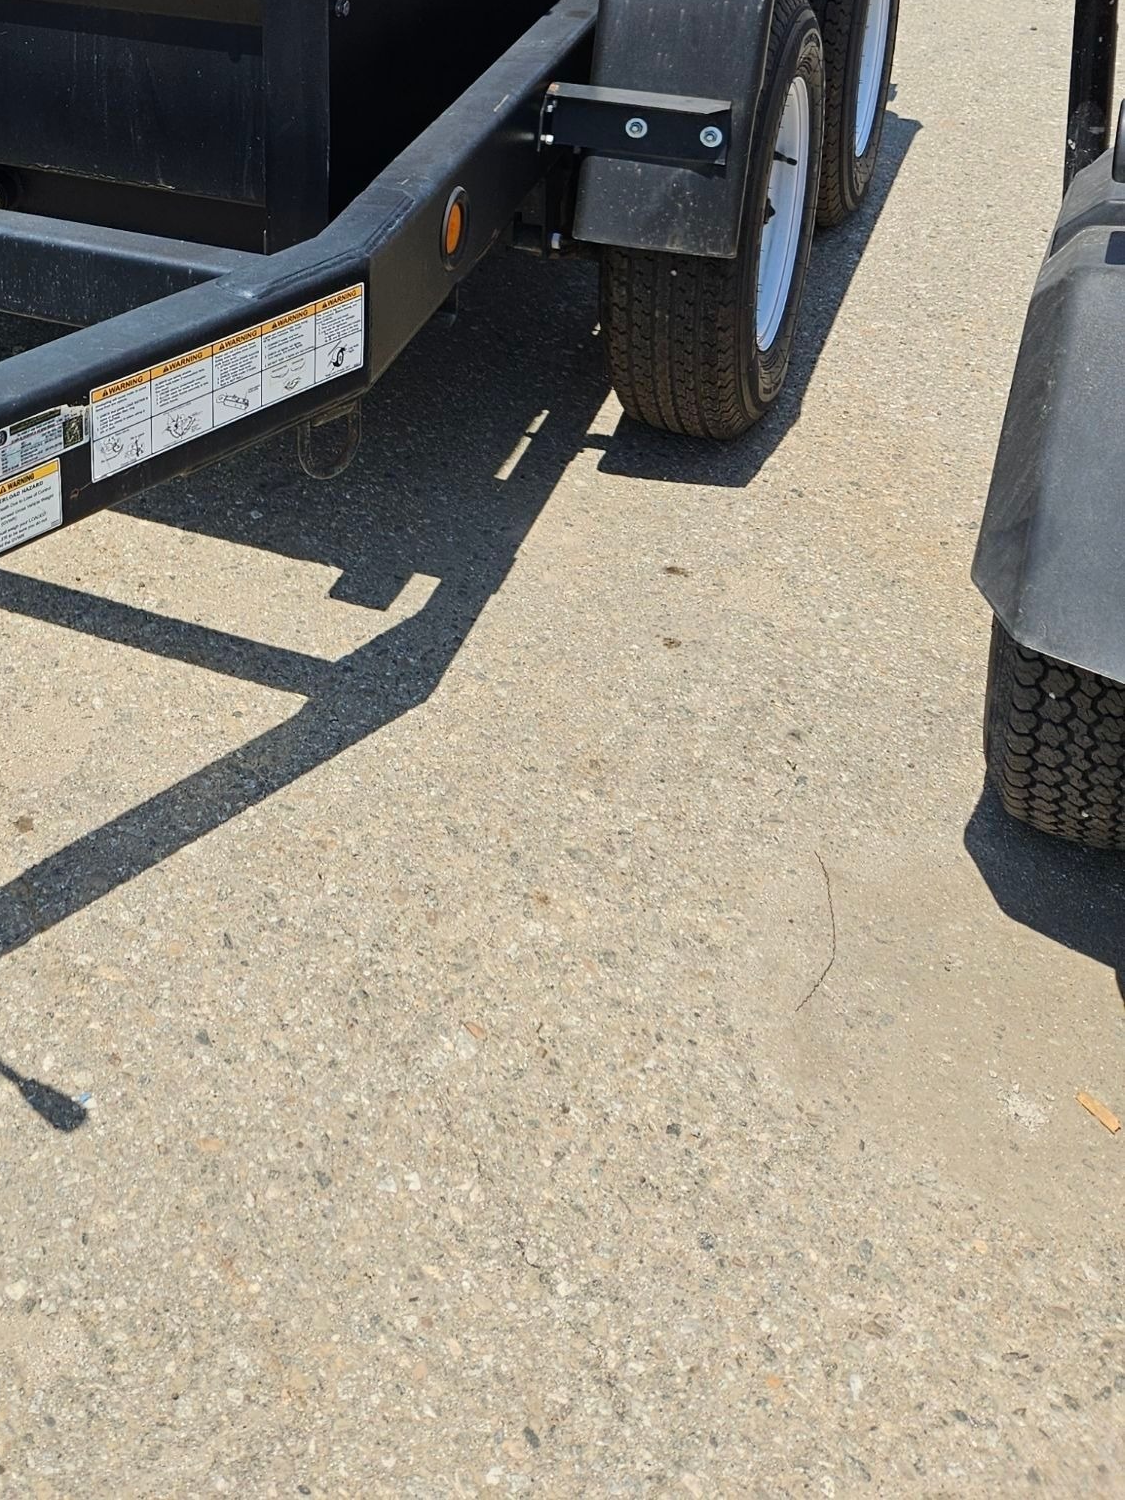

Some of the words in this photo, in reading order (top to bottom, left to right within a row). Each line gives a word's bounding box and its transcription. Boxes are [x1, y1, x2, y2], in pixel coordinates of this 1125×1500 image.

[328, 290, 356, 306] WARNING
[277, 310, 308, 326] WARNING
[225, 330, 257, 347] WARNING
[169, 352, 203, 370] WARNING
[109, 376, 143, 394] WARNING
[7, 473, 34, 490] WARNING
[22, 481, 43, 493] HAZARD
